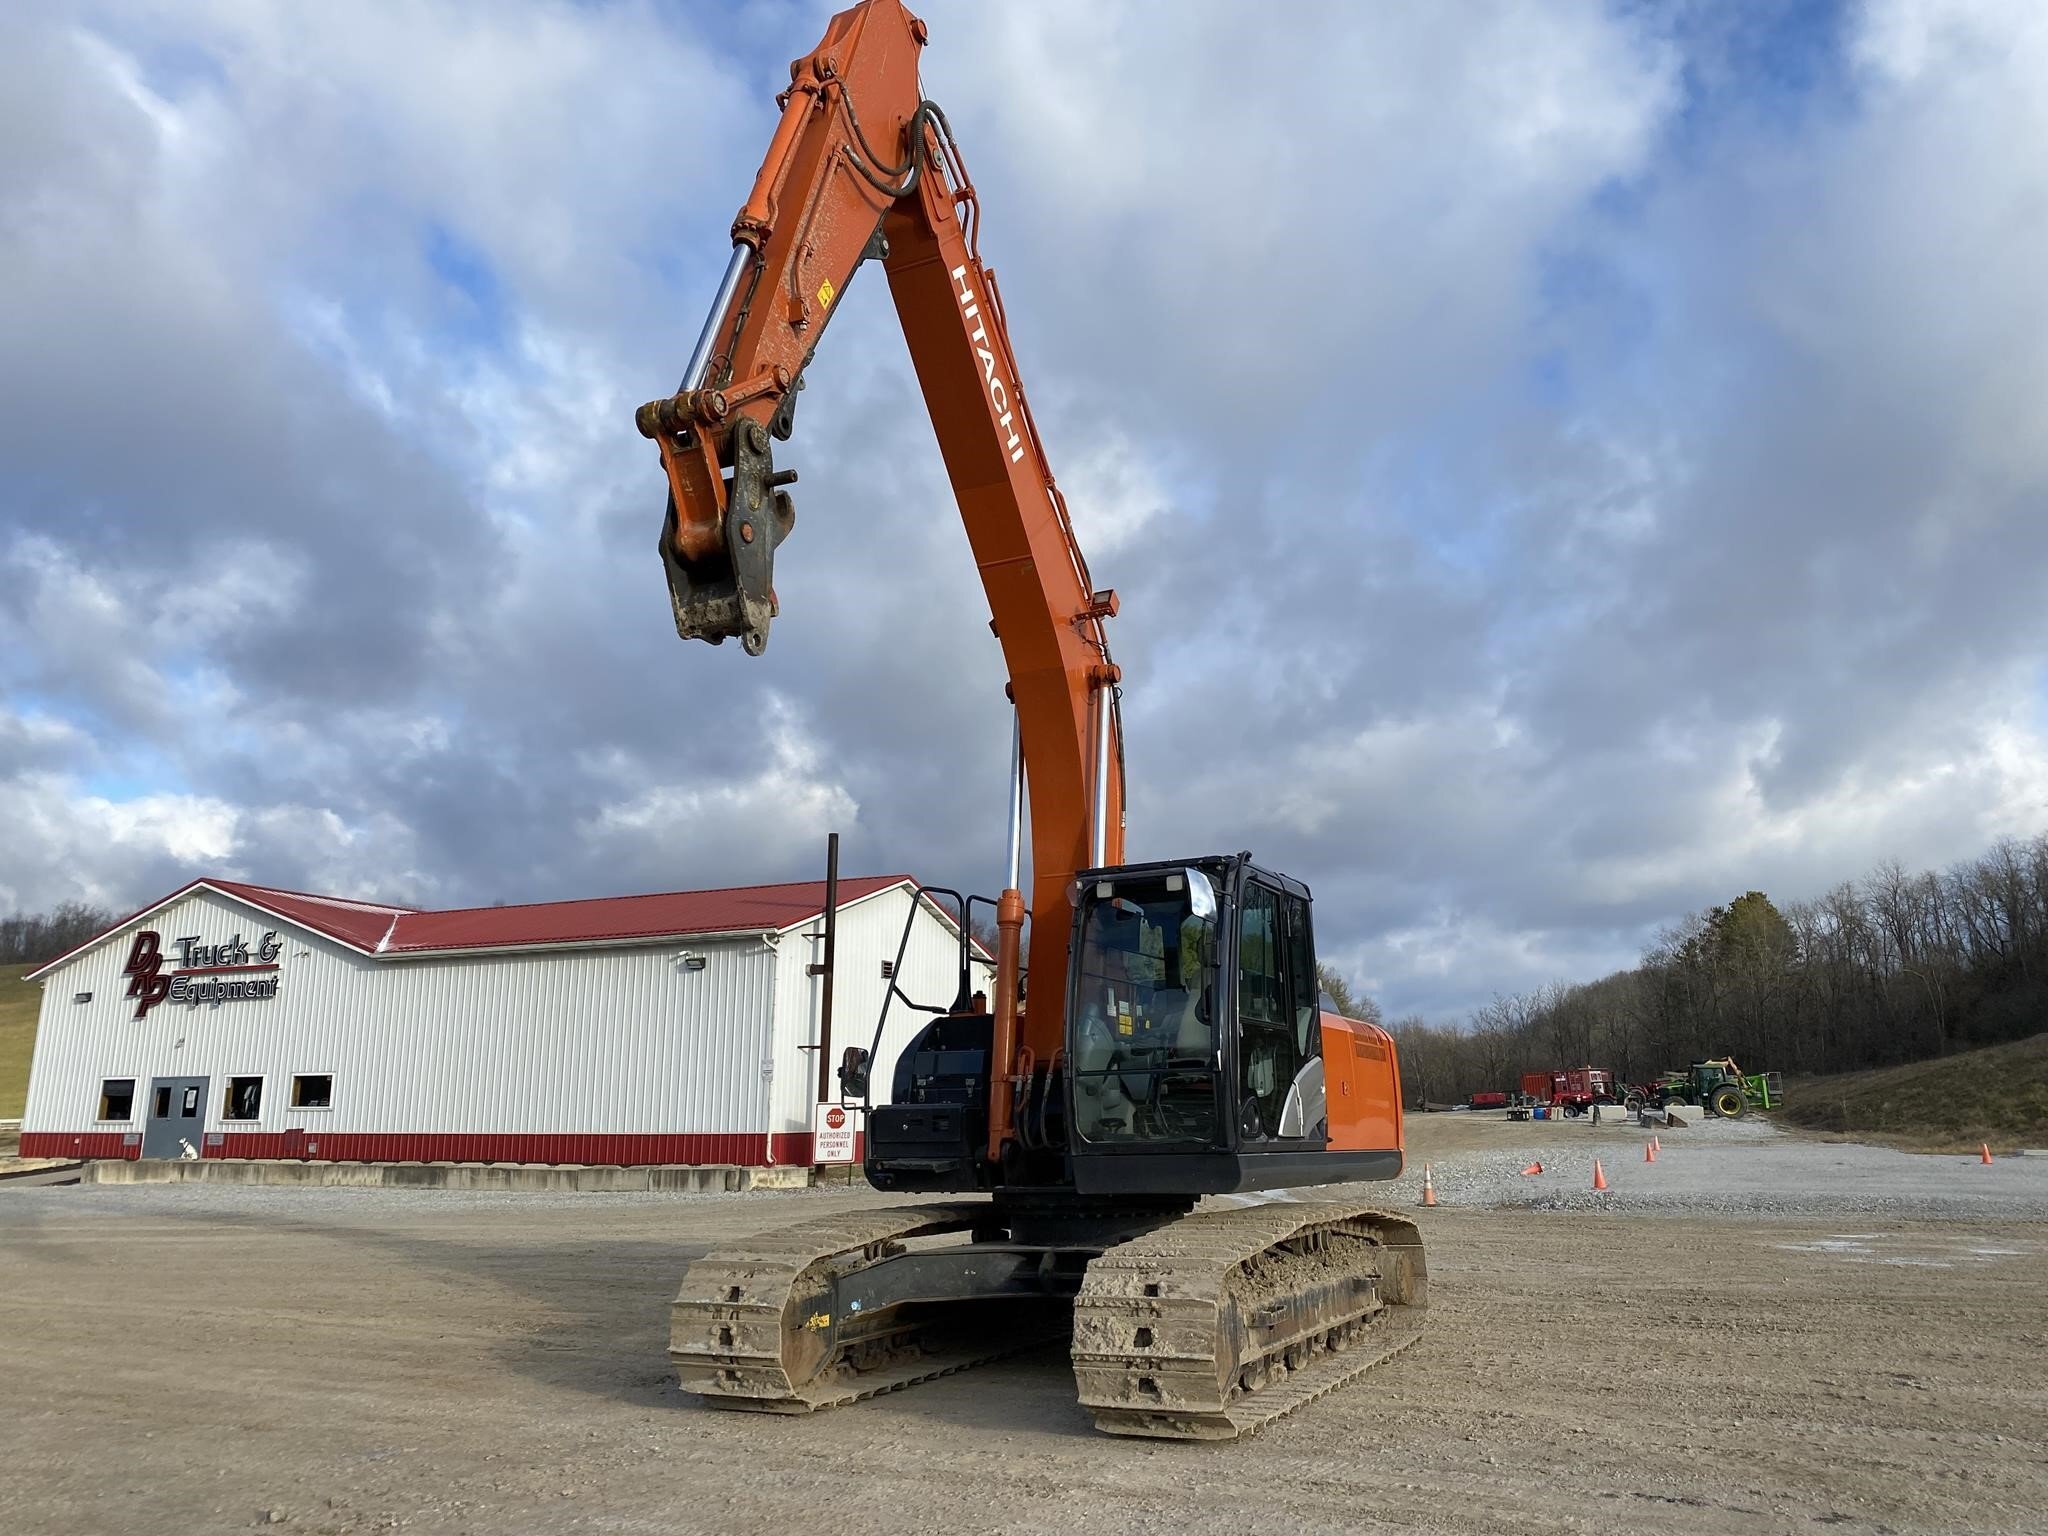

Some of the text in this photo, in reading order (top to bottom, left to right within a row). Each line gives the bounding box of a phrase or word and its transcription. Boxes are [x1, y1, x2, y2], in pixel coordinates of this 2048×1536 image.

[952, 264, 1024, 464] HITACHI
[176, 931, 283, 968] Truck &
[170, 975, 279, 1006] Equipment
[827, 1115, 844, 1123] STOP
